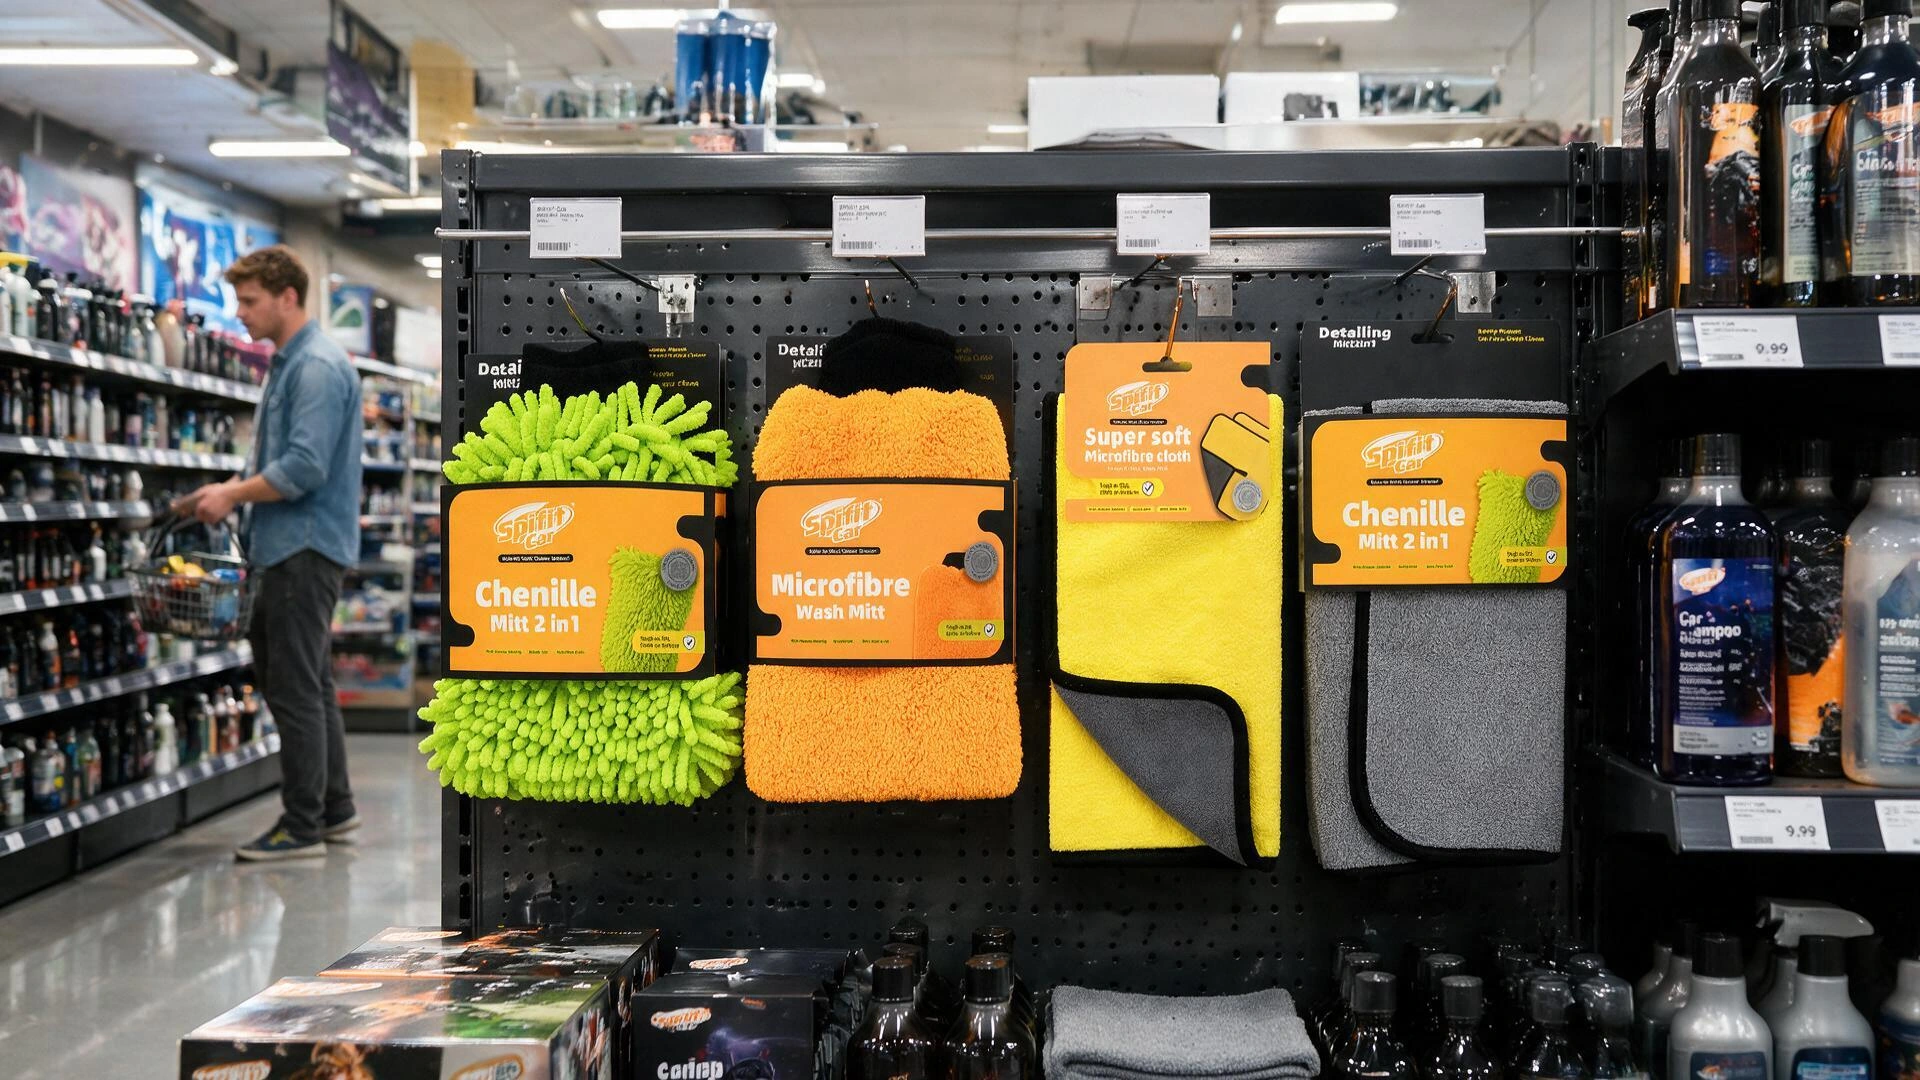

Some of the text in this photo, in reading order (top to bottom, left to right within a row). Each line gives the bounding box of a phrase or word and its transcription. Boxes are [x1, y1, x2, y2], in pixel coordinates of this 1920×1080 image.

[1085, 425, 1192, 449] Super soft
[1085, 449, 1191, 463] Microfibre cloth
[1342, 498, 1465, 527] Chenille
[1359, 532, 1398, 550] Mitt
[1403, 533, 1415, 550] 2
[475, 577, 597, 608] Chenille
[771, 571, 911, 598] Microfibre
[796, 603, 886, 621] Wash Mitt
[490, 613, 530, 633] Mitt
[534, 614, 546, 633] 2
[1785, 825, 1816, 837] 9.99
